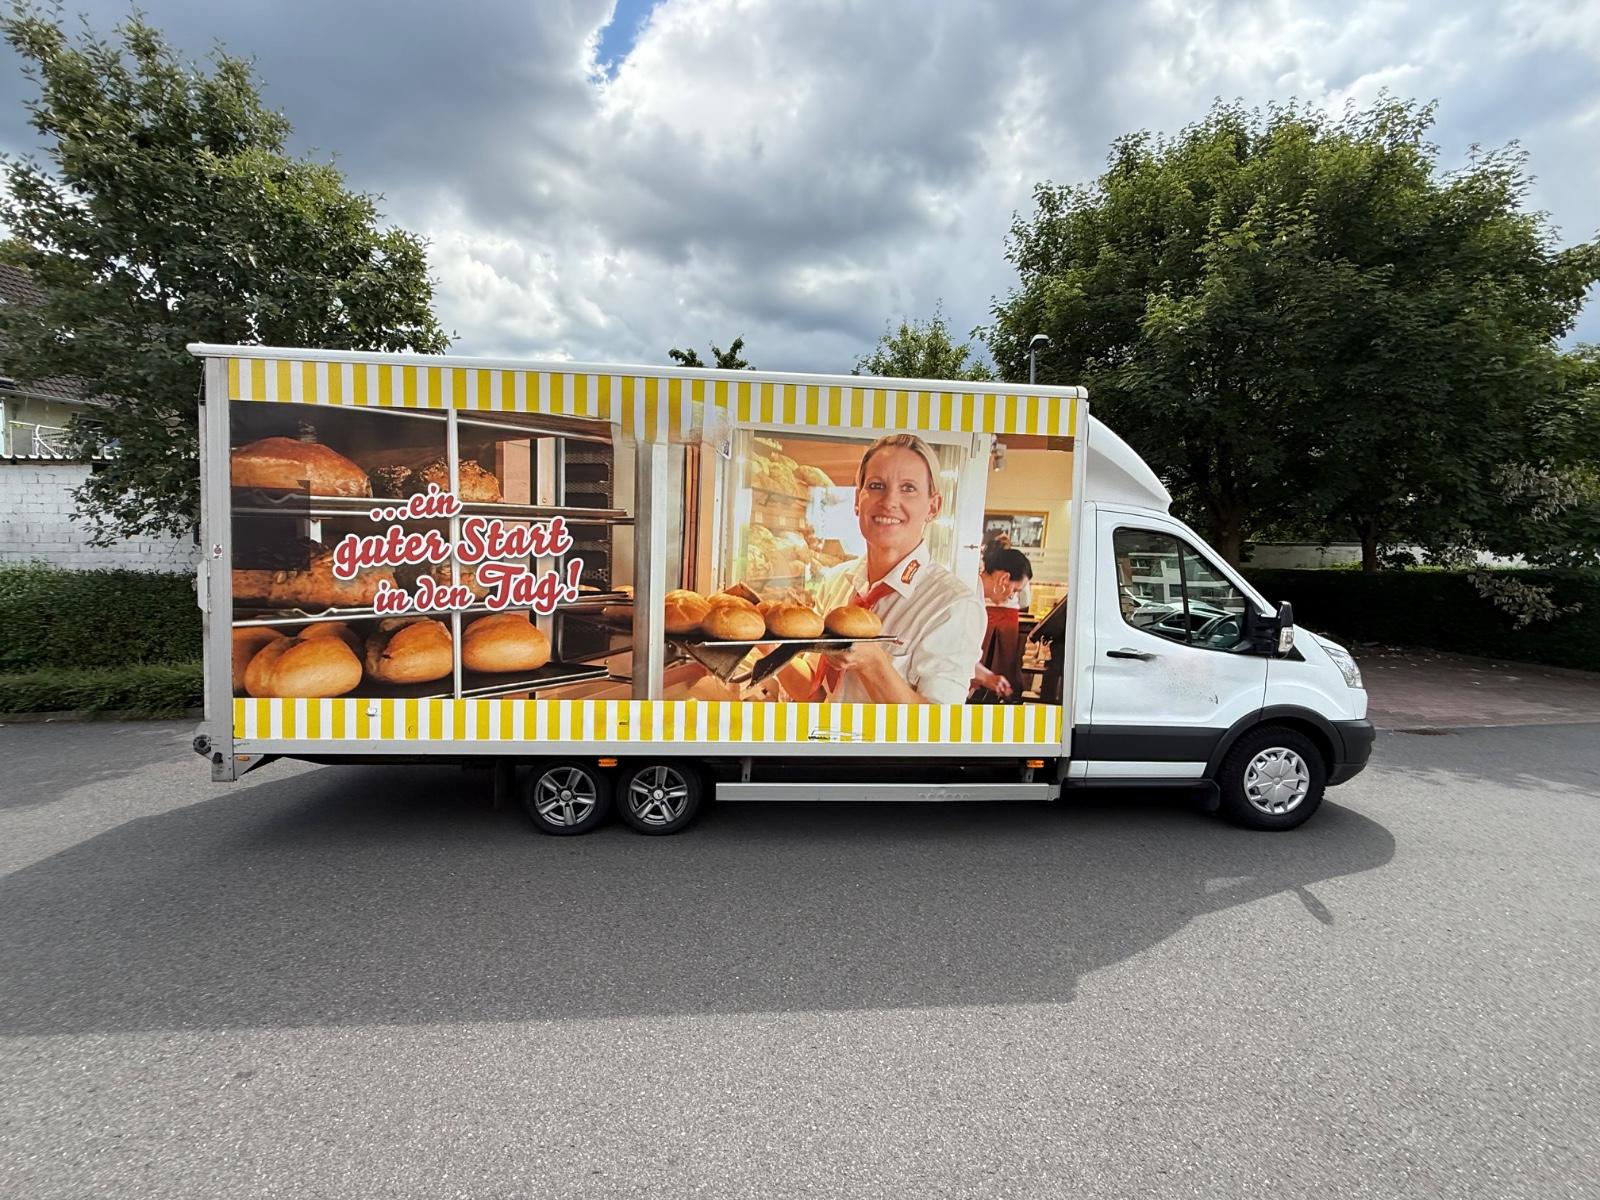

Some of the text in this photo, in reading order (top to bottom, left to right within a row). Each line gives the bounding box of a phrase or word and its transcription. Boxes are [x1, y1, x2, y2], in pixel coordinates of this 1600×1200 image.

[371, 484, 462, 521] ...ein
[333, 517, 573, 579] guter Start
[375, 558, 583, 615] in den Tag!
